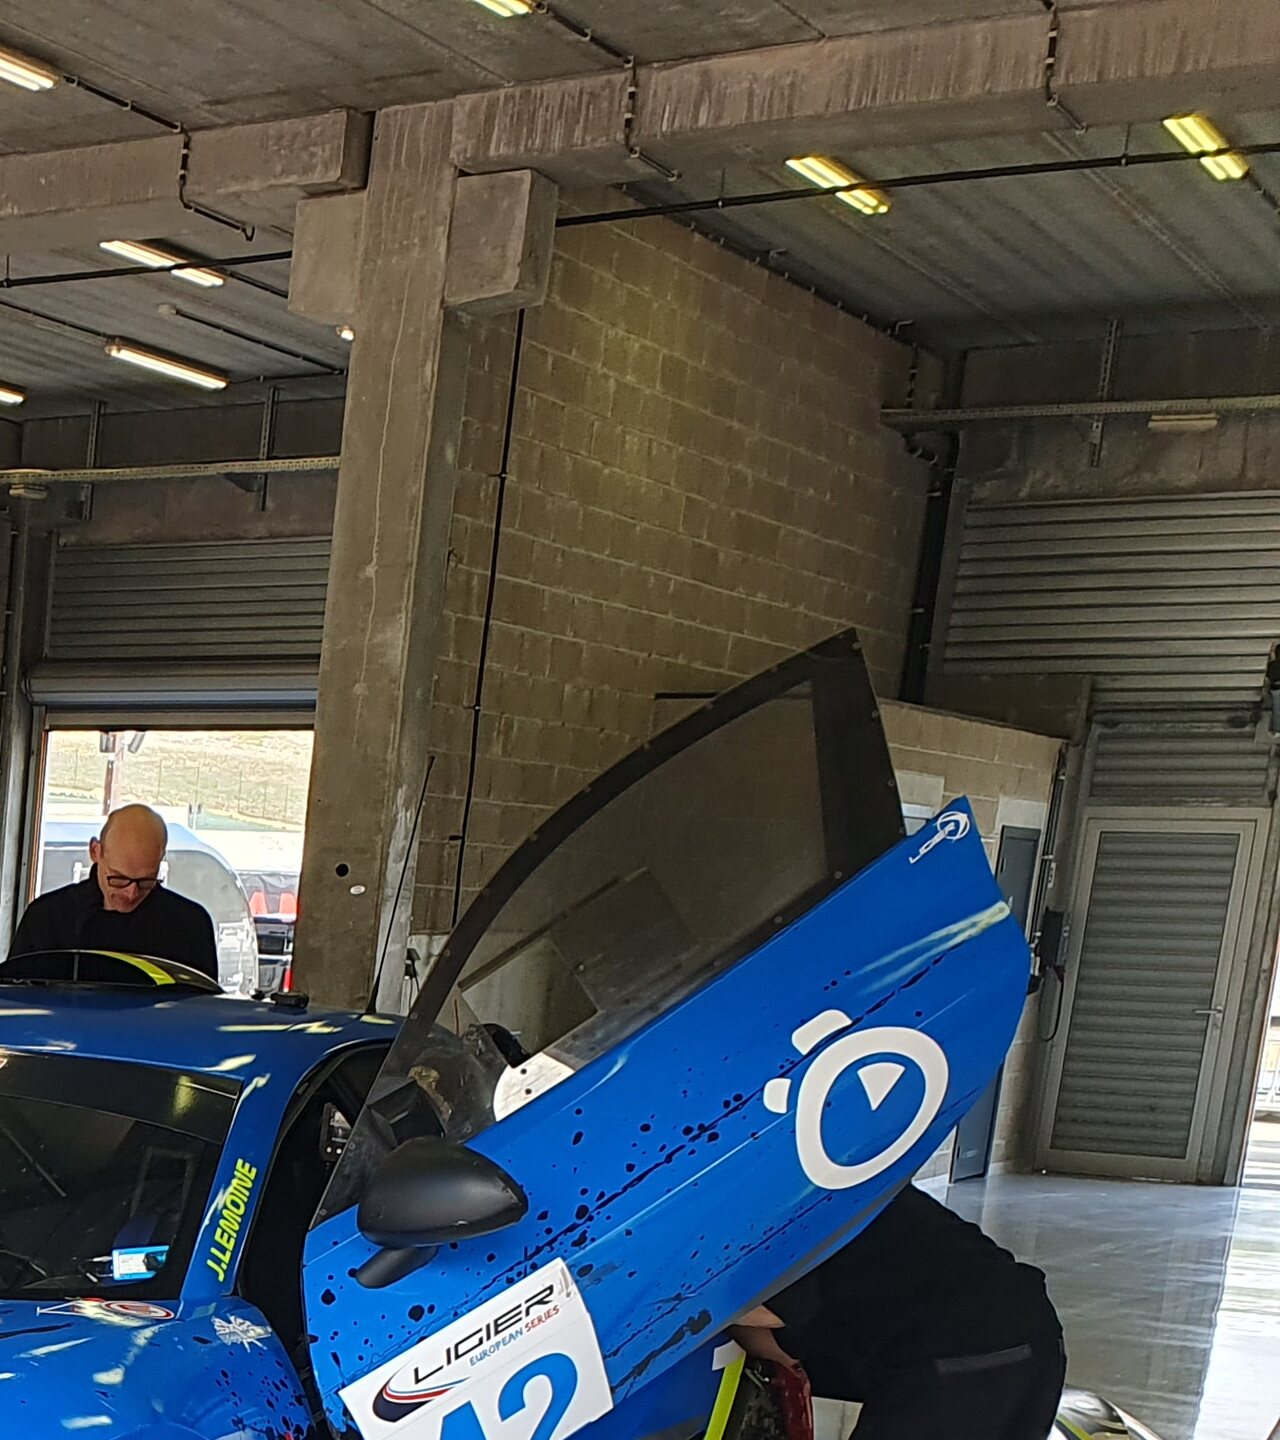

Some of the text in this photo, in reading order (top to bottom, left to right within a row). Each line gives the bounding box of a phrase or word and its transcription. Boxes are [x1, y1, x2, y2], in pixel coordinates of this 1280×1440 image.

[206, 1158, 257, 1282] J.LEMOINE
[414, 1284, 555, 1385] LIGIER
[469, 1304, 561, 1367] EUROPEAN SERIES
